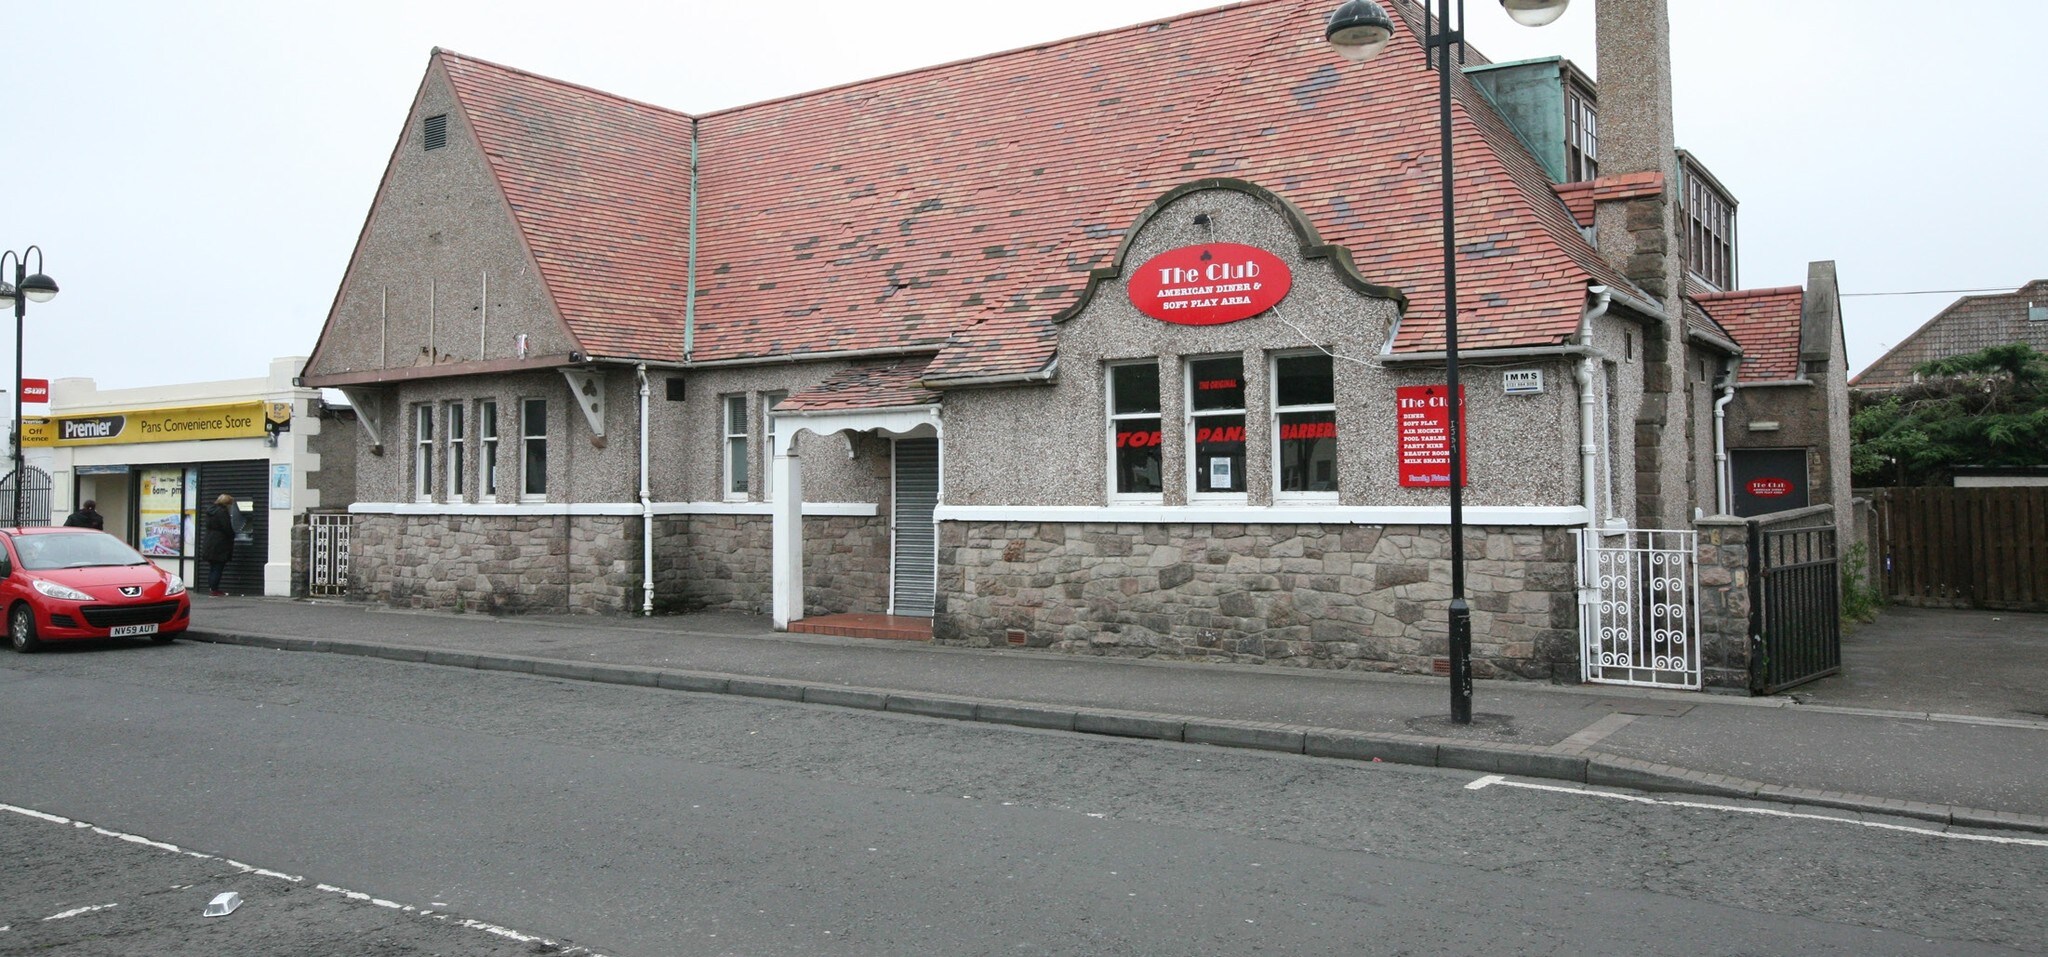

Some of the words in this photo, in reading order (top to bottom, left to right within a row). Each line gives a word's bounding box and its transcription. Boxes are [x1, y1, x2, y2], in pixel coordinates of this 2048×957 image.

[1159, 267, 1199, 285] The
[1205, 260, 1260, 281] Club
[1157, 286, 1214, 298] AMERICAN
[1216, 283, 1251, 294] DINER
[1253, 282, 1262, 290] &
[1163, 301, 1188, 310] SOFT
[1191, 298, 1219, 307] PLAY
[1220, 296, 1251, 305] AREA
[1505, 372, 1537, 381] IMMS
[1400, 398, 1425, 408] The
[1429, 397, 1463, 407] Cl
[65, 420, 112, 438] Premier
[141, 419, 162, 433] Pans
[164, 418, 222, 432] Convenience
[225, 415, 251, 428] Store
[1116, 431, 1162, 448] TOP
[1431, 474, 1450, 482] Friend
[114, 626, 137, 635] NV59
[139, 624, 155, 633] AUT
